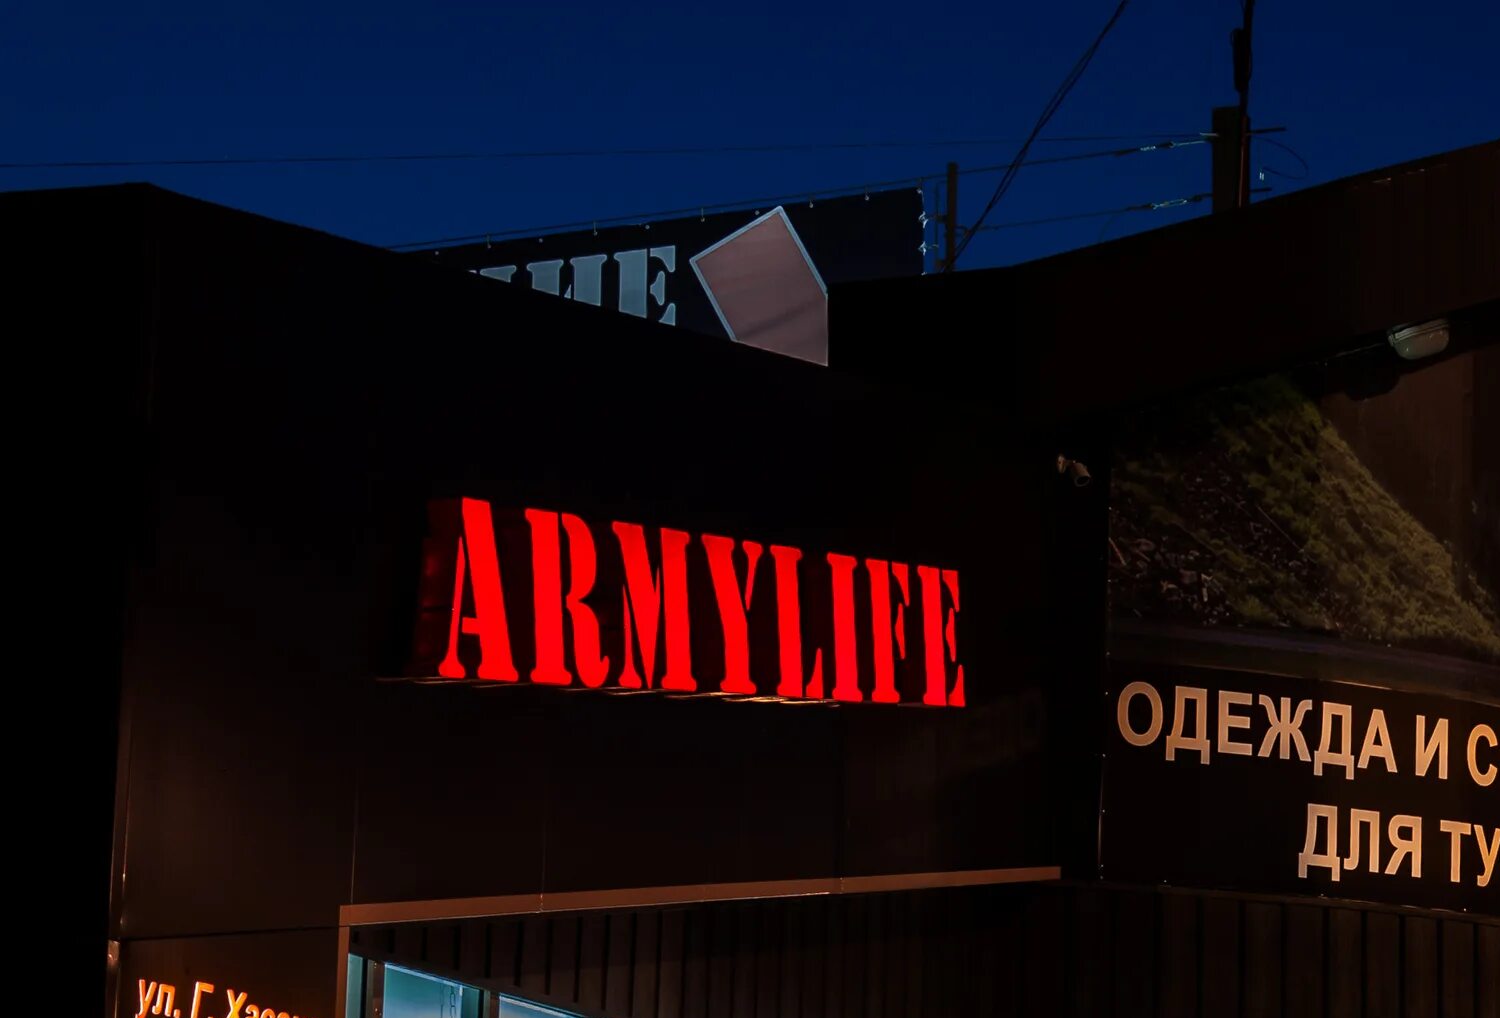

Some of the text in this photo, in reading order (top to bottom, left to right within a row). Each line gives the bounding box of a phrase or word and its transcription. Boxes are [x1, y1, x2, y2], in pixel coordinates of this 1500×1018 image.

[438, 497, 966, 708] ARMYLIFE
[1116, 681, 1398, 780] ОДЕЖДА
[1415, 714, 1449, 780] И
[1298, 802, 1422, 882] ДЛЯ
